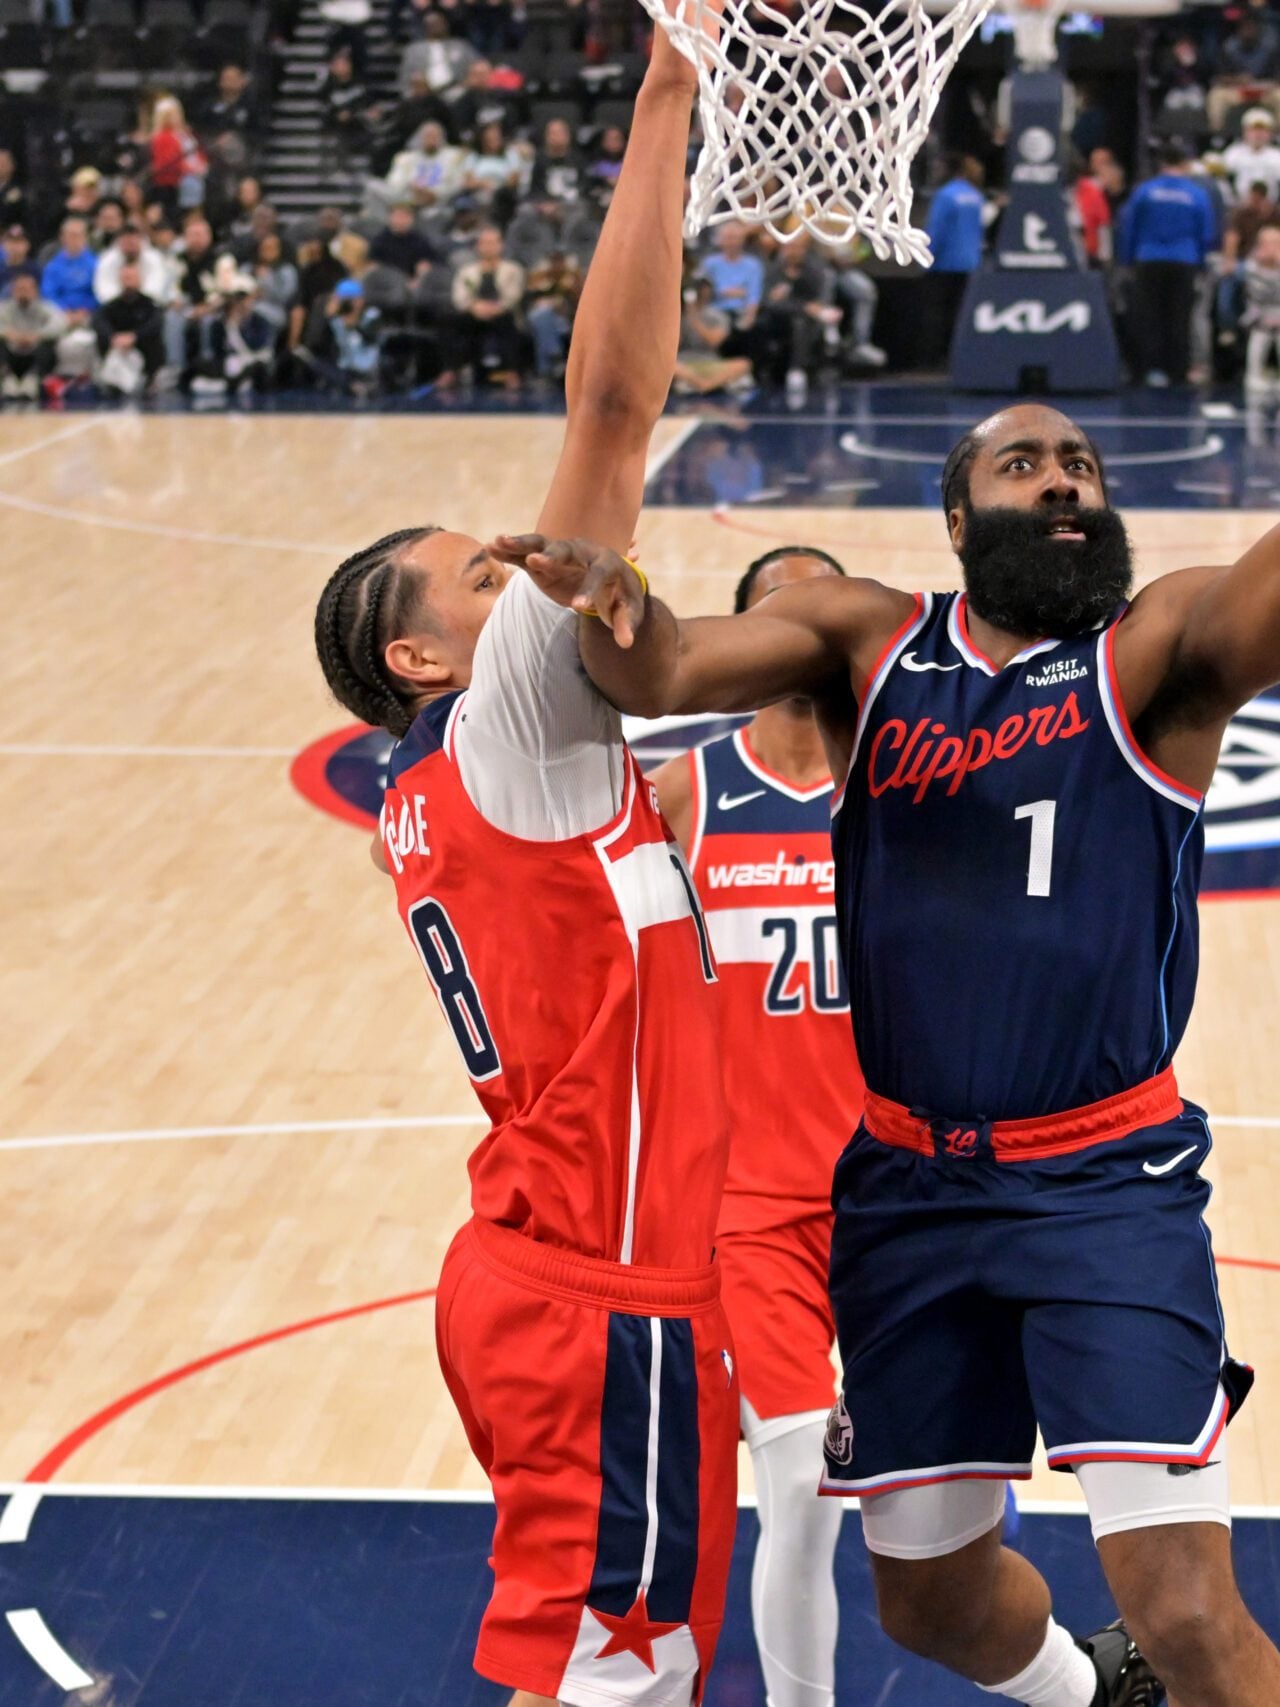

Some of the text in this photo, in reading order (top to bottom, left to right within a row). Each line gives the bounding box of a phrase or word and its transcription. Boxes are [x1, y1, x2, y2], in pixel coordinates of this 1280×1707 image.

[973, 302, 1091, 333] KIA
[1026, 666, 1088, 688] RWANDA
[1042, 658, 1078, 676] VISIT
[868, 691, 1090, 804] Clippers
[1014, 799, 1057, 897] 1
[707, 850, 836, 893] washing
[761, 916, 851, 1016] 20
